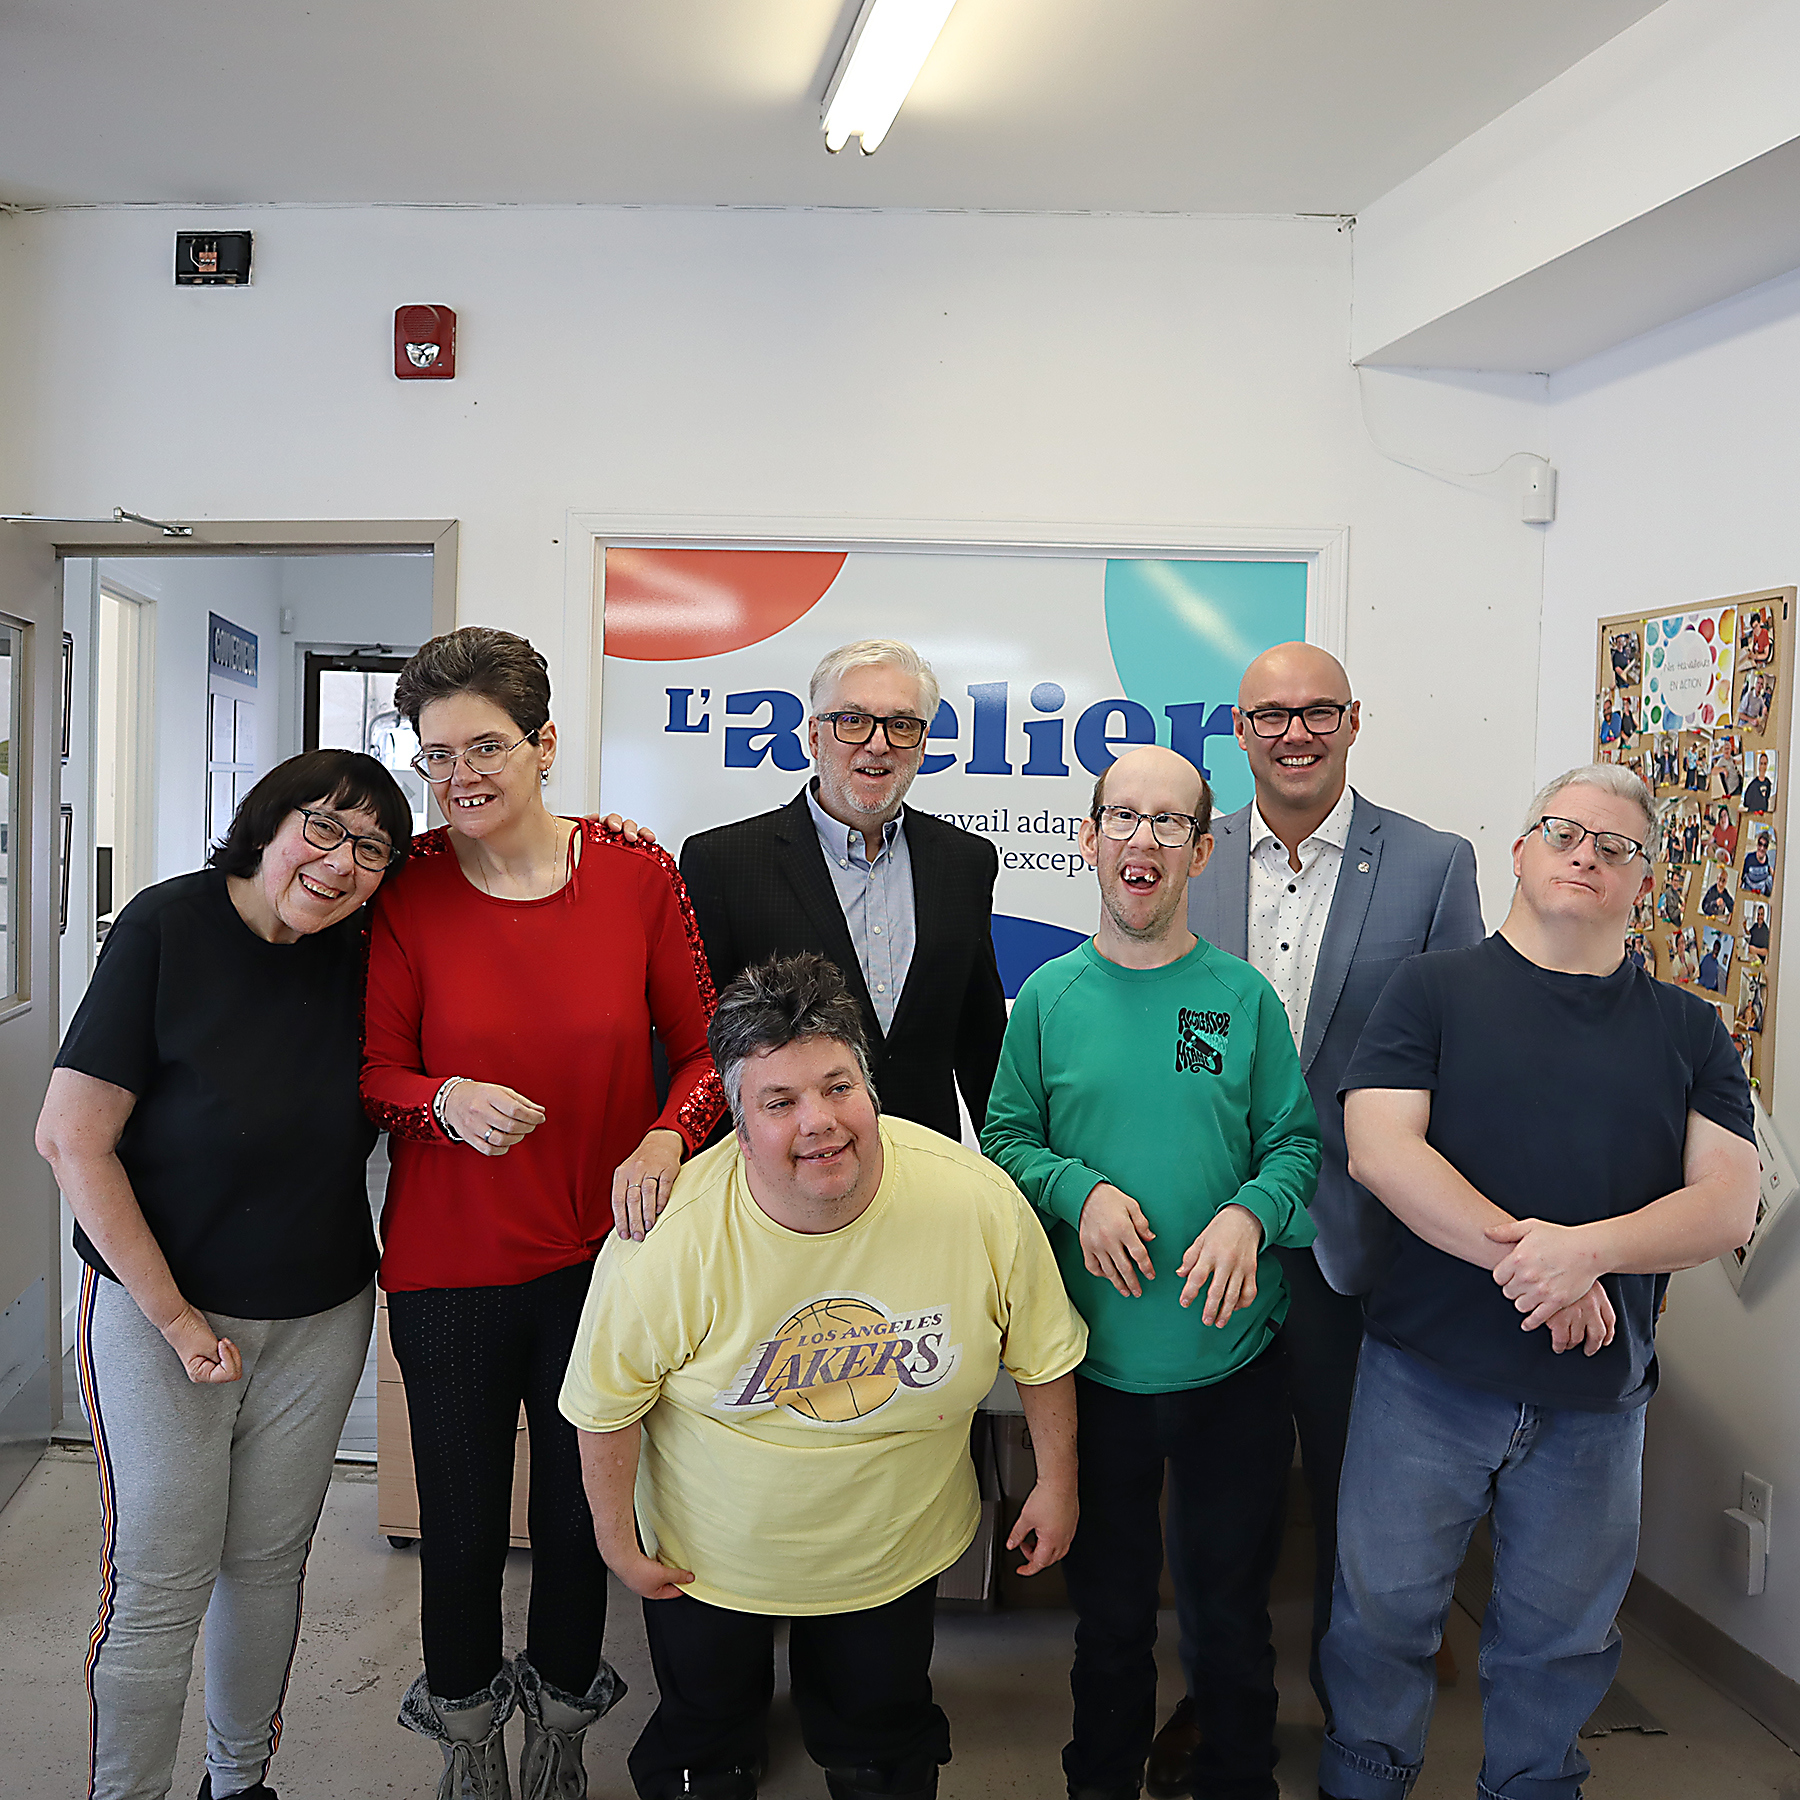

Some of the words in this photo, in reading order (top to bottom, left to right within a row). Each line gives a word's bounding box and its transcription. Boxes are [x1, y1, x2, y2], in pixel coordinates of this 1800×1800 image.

[1178, 1007, 1231, 1038] ALLIGATOR
[798, 1329, 838, 1348] LOS
[839, 1312, 943, 1341] ANGELES
[724, 1332, 955, 1406] LAKERS
